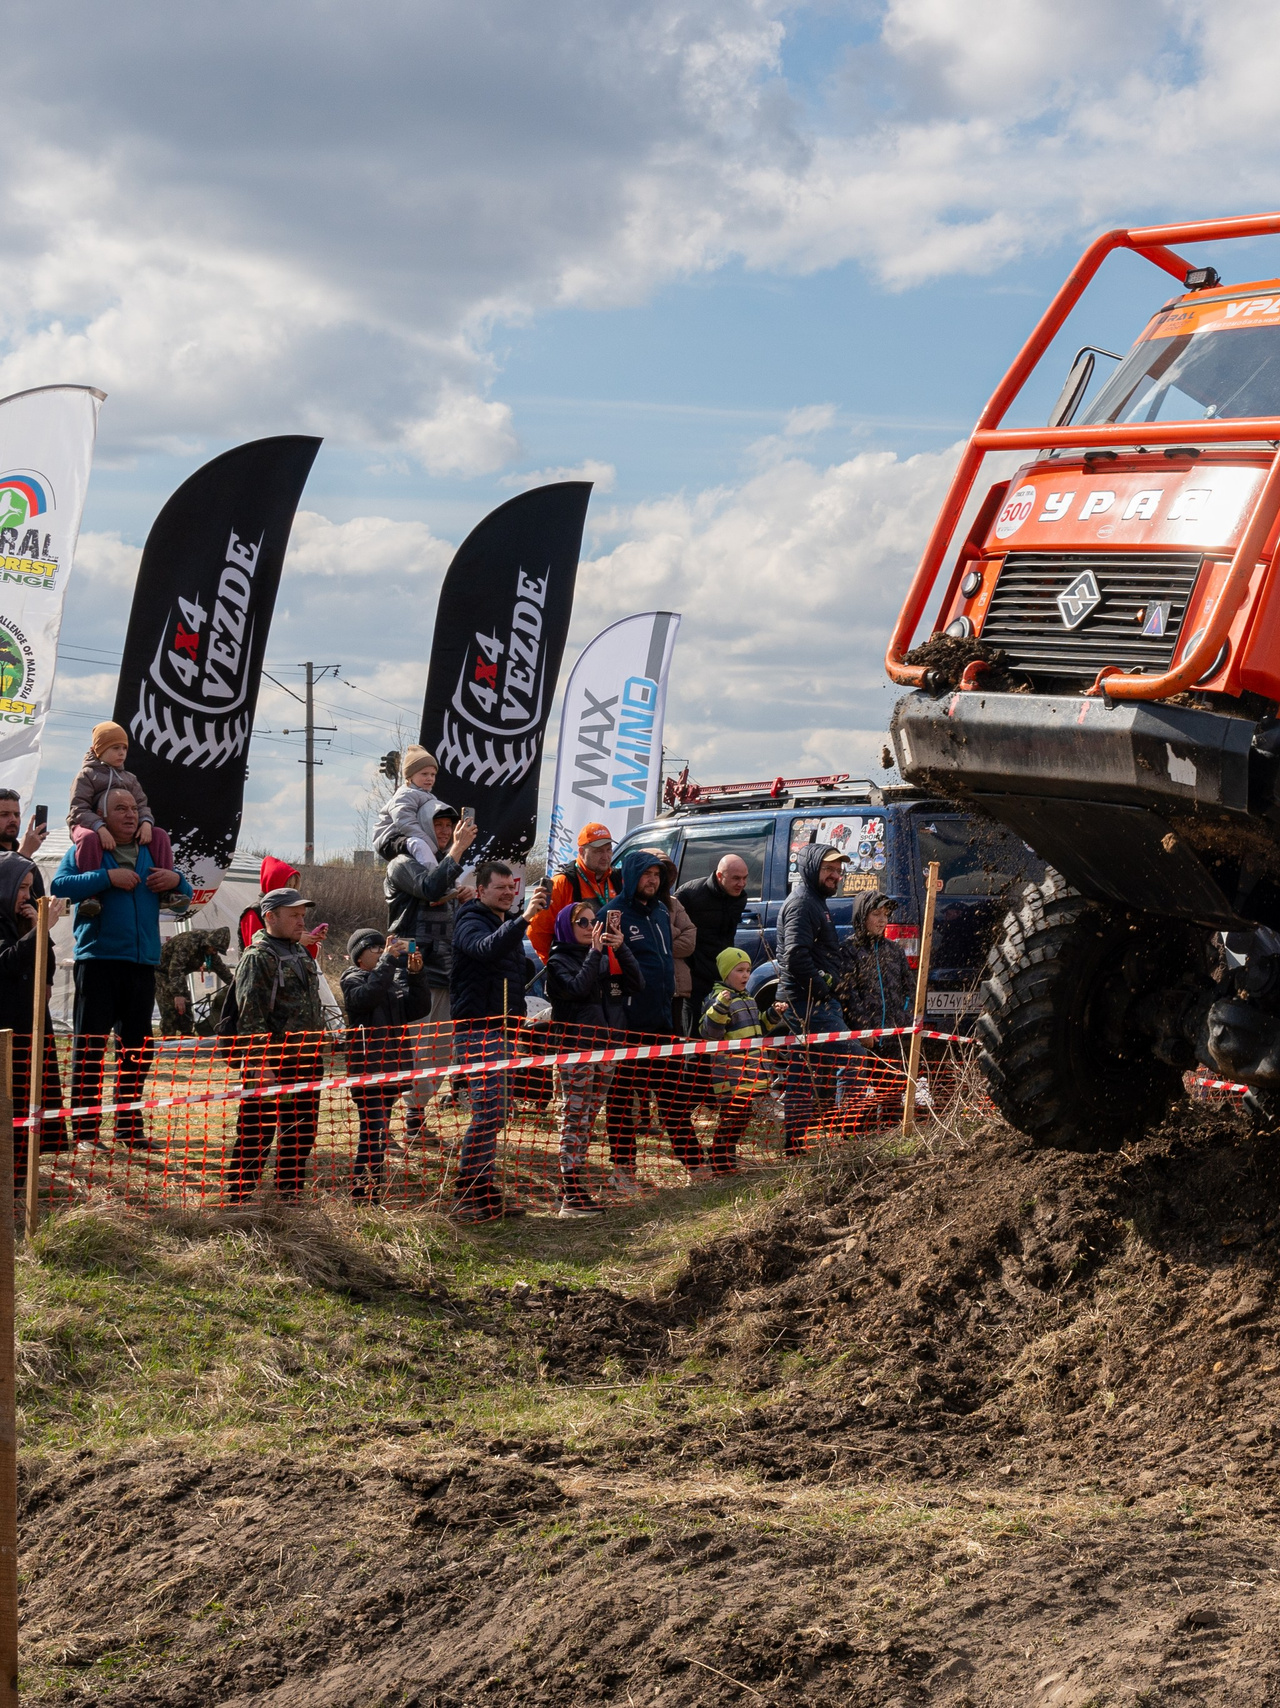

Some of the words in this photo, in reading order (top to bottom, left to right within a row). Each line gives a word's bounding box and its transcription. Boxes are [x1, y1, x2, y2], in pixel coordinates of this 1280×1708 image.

[1157, 312, 1195, 325] URAL
[1000, 501, 1032, 522] 500
[1038, 489, 1213, 522] УРАЛ
[0, 571, 55, 590] NGE
[202, 526, 265, 698] VEZDE
[23, 645, 33, 656] OF
[500, 565, 550, 721] VEZDE
[20, 658, 36, 699] MALAYSIA
[0, 713, 36, 726] GE
[571, 688, 619, 808] MAX
[608, 675, 658, 809] WIND
